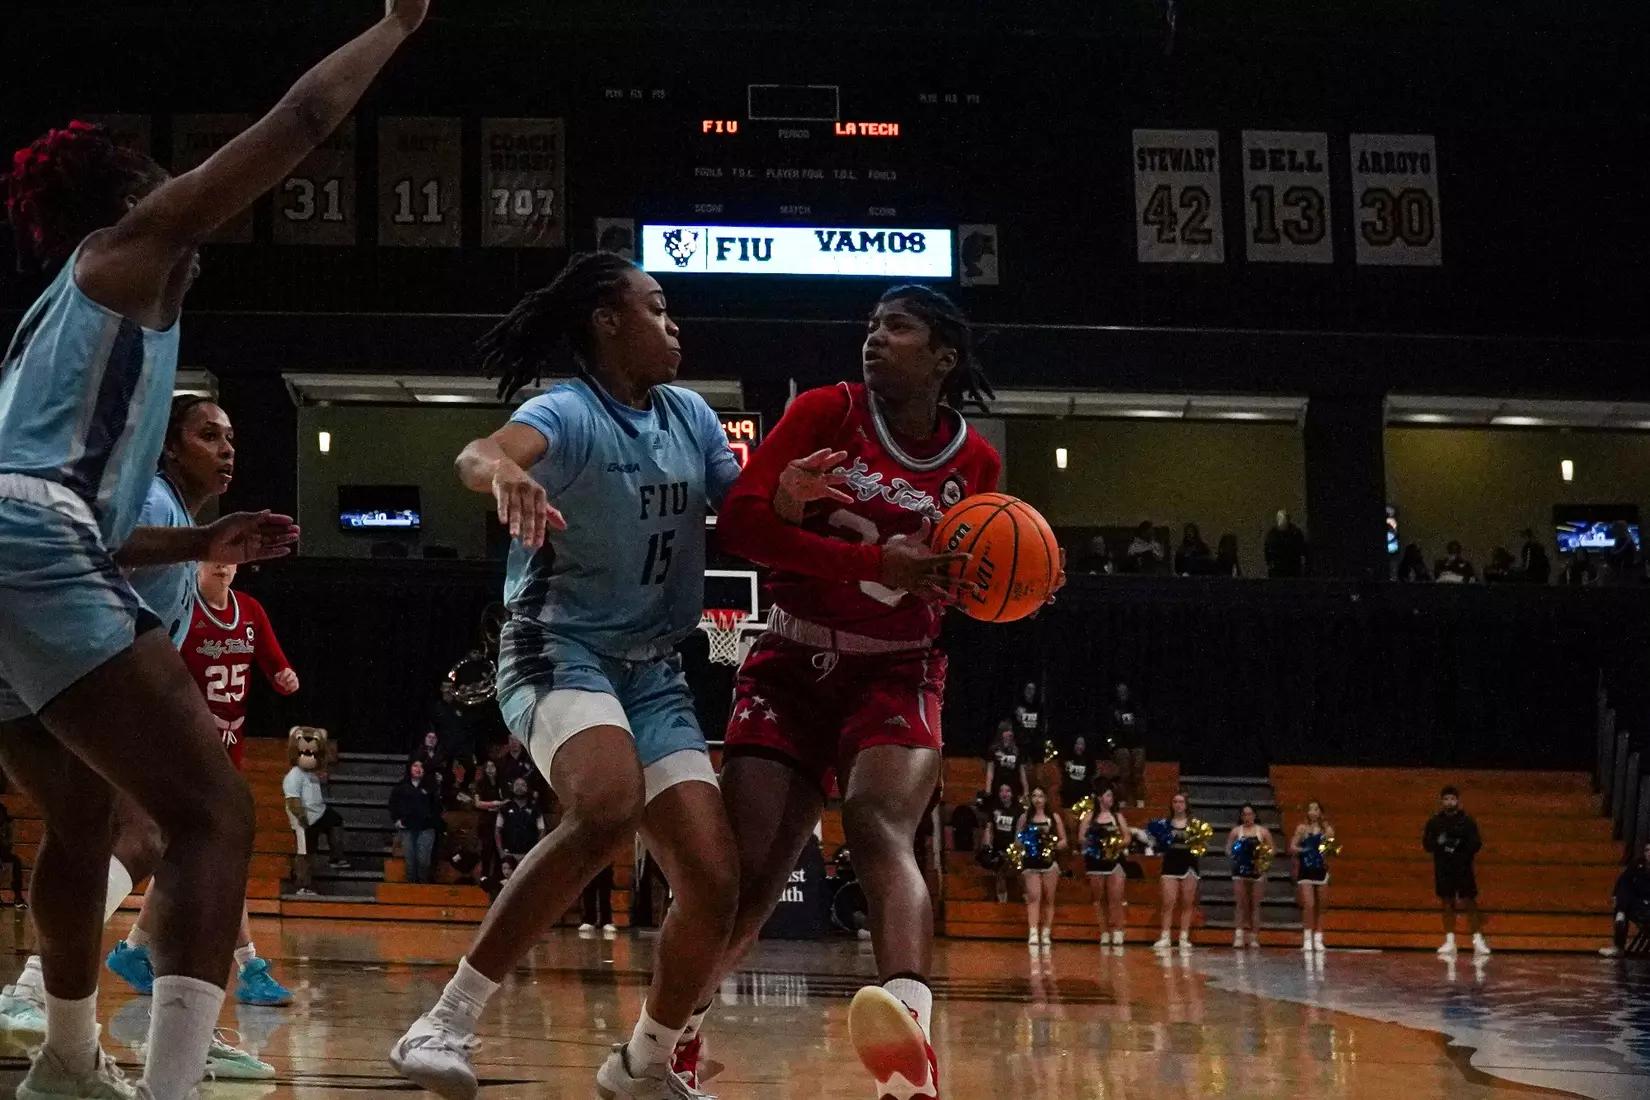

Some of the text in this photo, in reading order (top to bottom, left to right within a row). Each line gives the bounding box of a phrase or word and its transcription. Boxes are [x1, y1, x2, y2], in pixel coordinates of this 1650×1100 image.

[702, 120, 738, 133] FIU
[835, 122, 900, 136] LA TECH
[1136, 148, 1215, 173] STEWART
[1249, 148, 1324, 173] BELL
[1357, 150, 1432, 175] ARROYO
[283, 178, 345, 222] 31
[394, 179, 444, 223] 11
[491, 189, 555, 215] 707
[1143, 184, 1213, 245] 42
[1250, 184, 1326, 246] 13
[1360, 187, 1434, 248] 30
[715, 236, 774, 262] FIU
[639, 481, 688, 520] FIU
[640, 529, 676, 585] 15
[204, 663, 251, 703] 25
